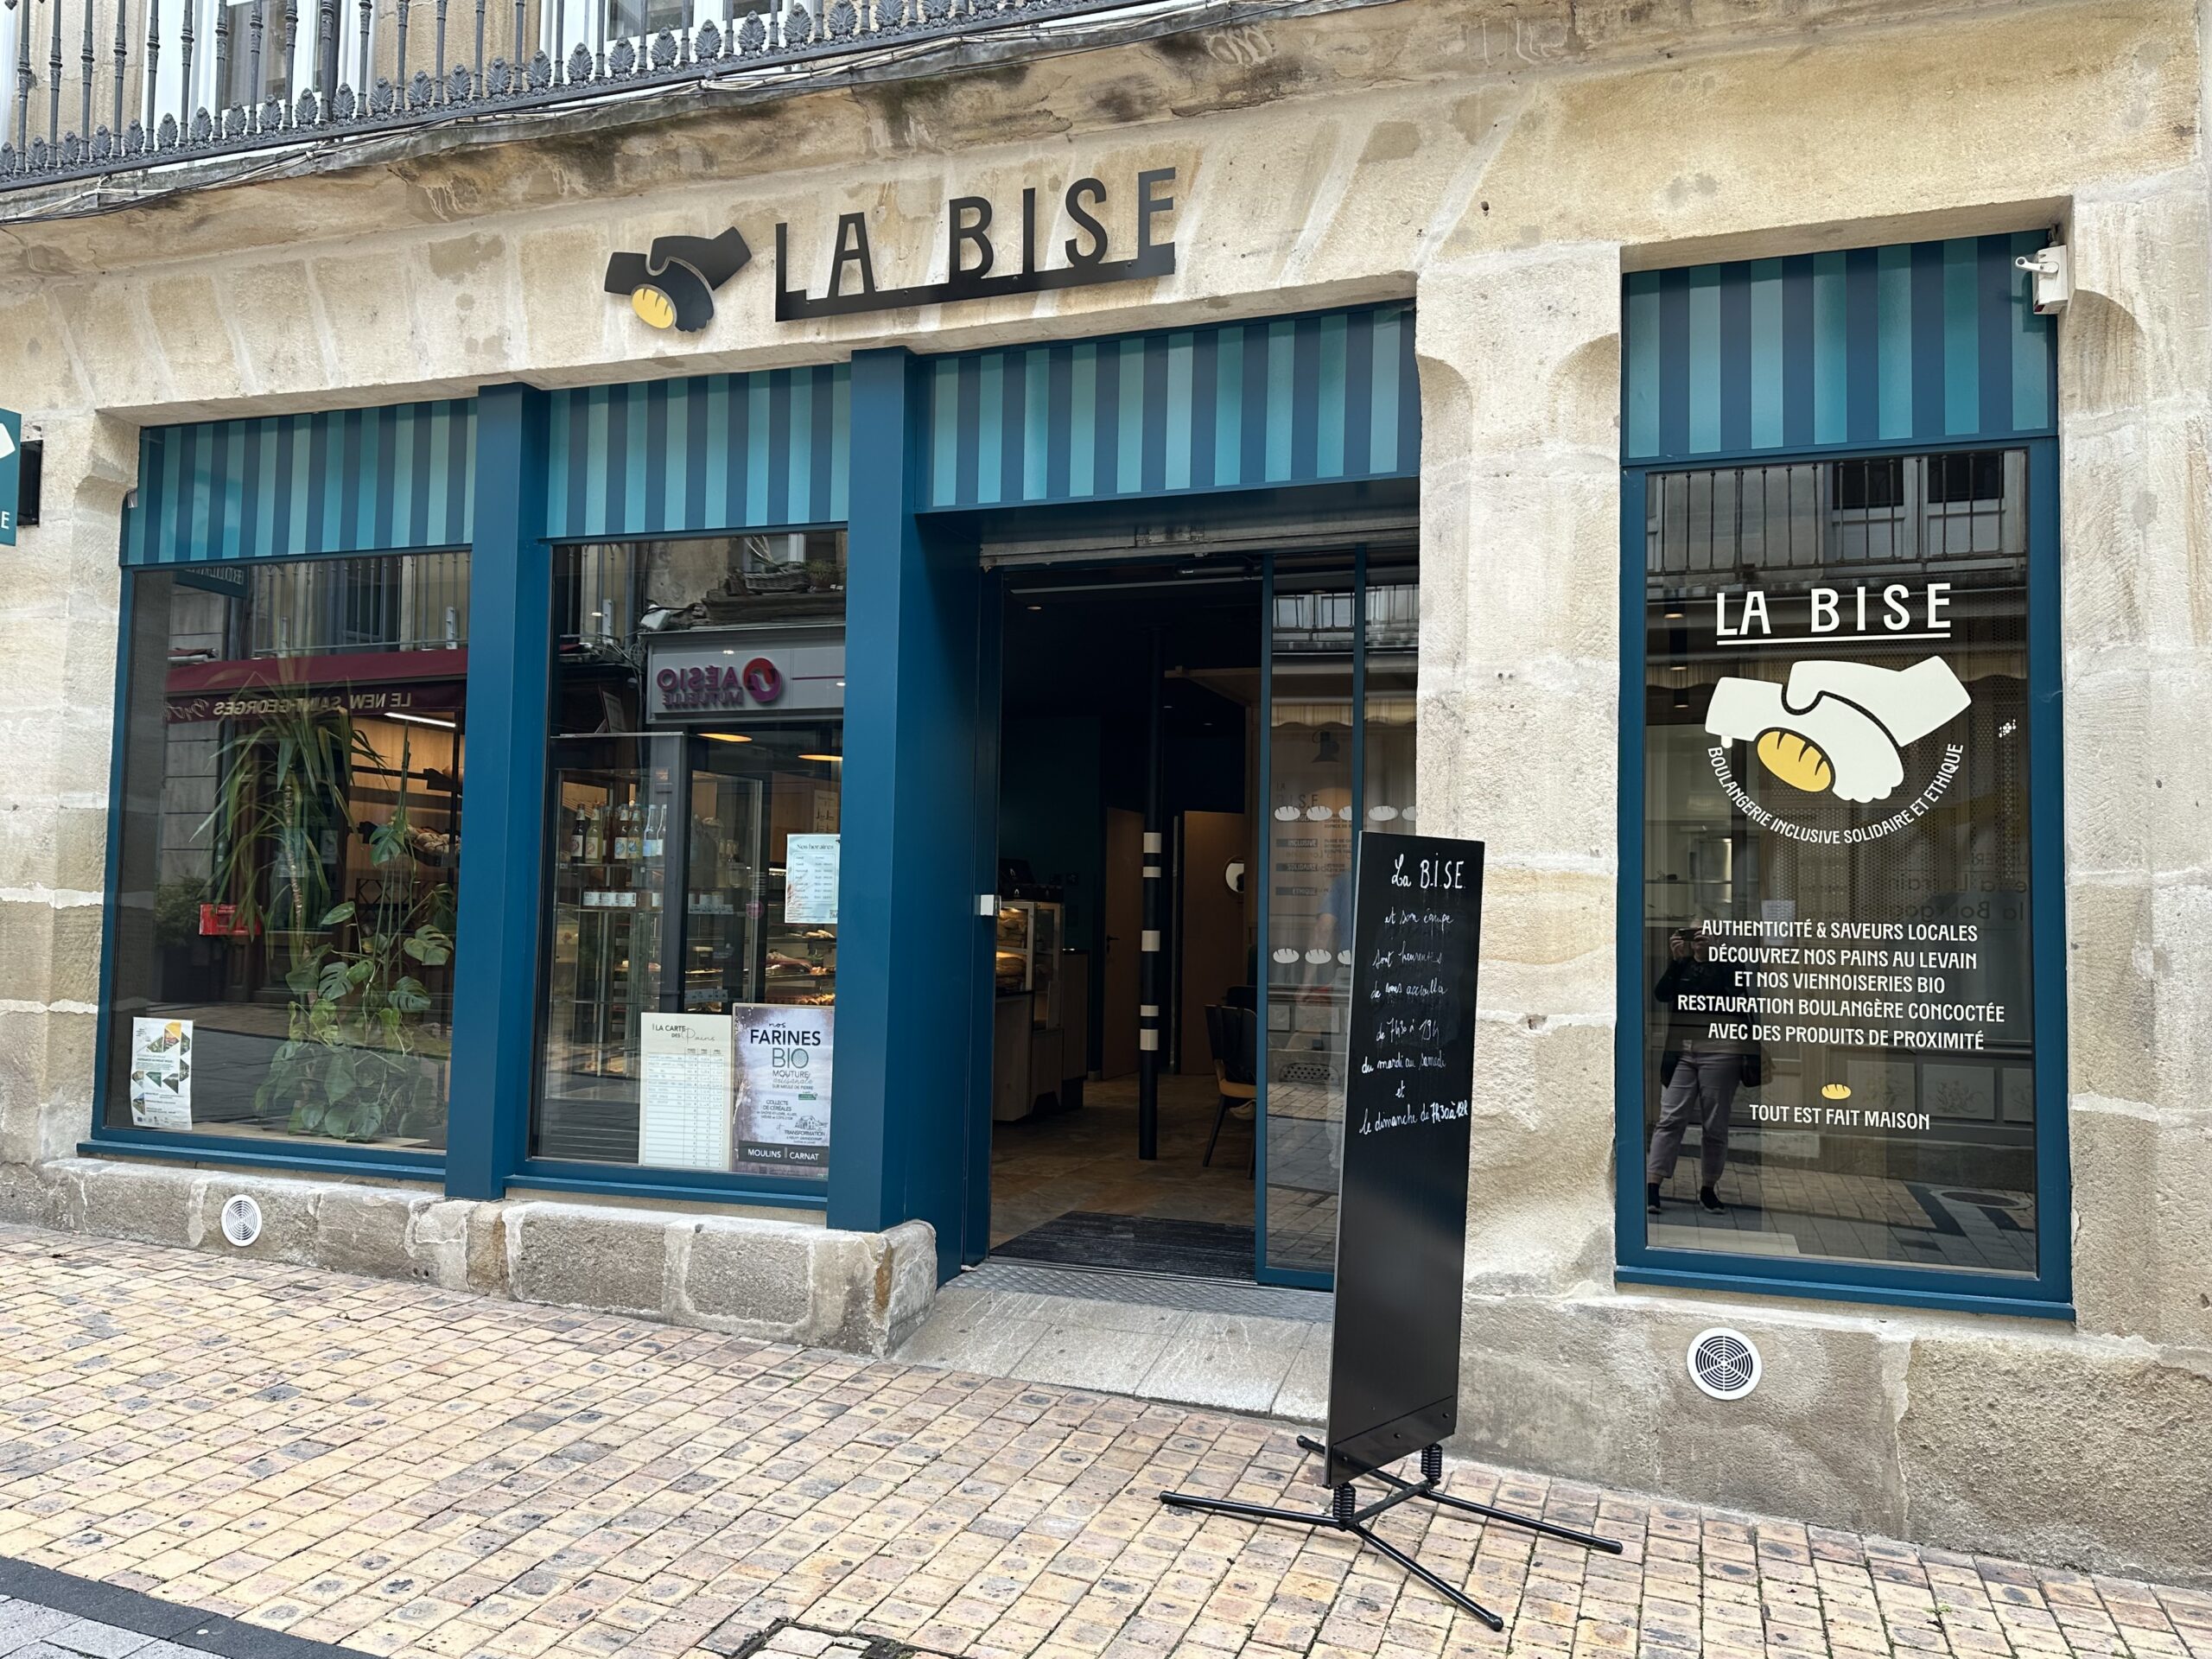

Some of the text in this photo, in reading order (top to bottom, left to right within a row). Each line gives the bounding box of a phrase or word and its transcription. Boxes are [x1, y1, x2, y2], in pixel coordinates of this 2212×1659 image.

[776, 168, 1176, 321] LA BISE
[1716, 582, 1951, 636] LA BISE
[1707, 743, 1963, 844] BOULANGERIE INCLUSIVE SOLIDAIRE ET ETHIQUE
[1391, 853, 1412, 887] La
[1384, 906, 1455, 934] et son équipe
[1701, 918, 1978, 942] AUTHENTICITÉ & SAVEURS LOCALES
[1372, 949, 1395, 969] sont
[1708, 944, 1977, 970] DÉCOUVREZ NOS PAINS AU LEVAIN
[1370, 981, 1382, 1000] de
[1385, 982, 1402, 995] vous
[1735, 970, 1945, 994] ET NOS VIENNOISERIES BIO
[1678, 995, 2005, 1023] RESTAURATION BOULANGÈRE CONCOCTÉE
[750, 1029, 821, 1046] FARINES
[1376, 1022, 1386, 1041] de
[1708, 1023, 1985, 1050] AVEC DES PRODUITS DE PROXIMITÉ
[772, 1047, 809, 1069] BIO
[1362, 1049, 1446, 1073] du mardi au samedi
[772, 1070, 810, 1078] MOUTURE
[1395, 1079, 1406, 1098] et
[1359, 1108, 1372, 1135] le
[1375, 1103, 1418, 1132] dimanche
[1420, 1103, 1430, 1122] de
[1750, 1104, 1930, 1130] TOUT EST FAIT MAISON
[747, 1148, 782, 1159] MOULINS
[789, 1152, 820, 1161] CARNAT
